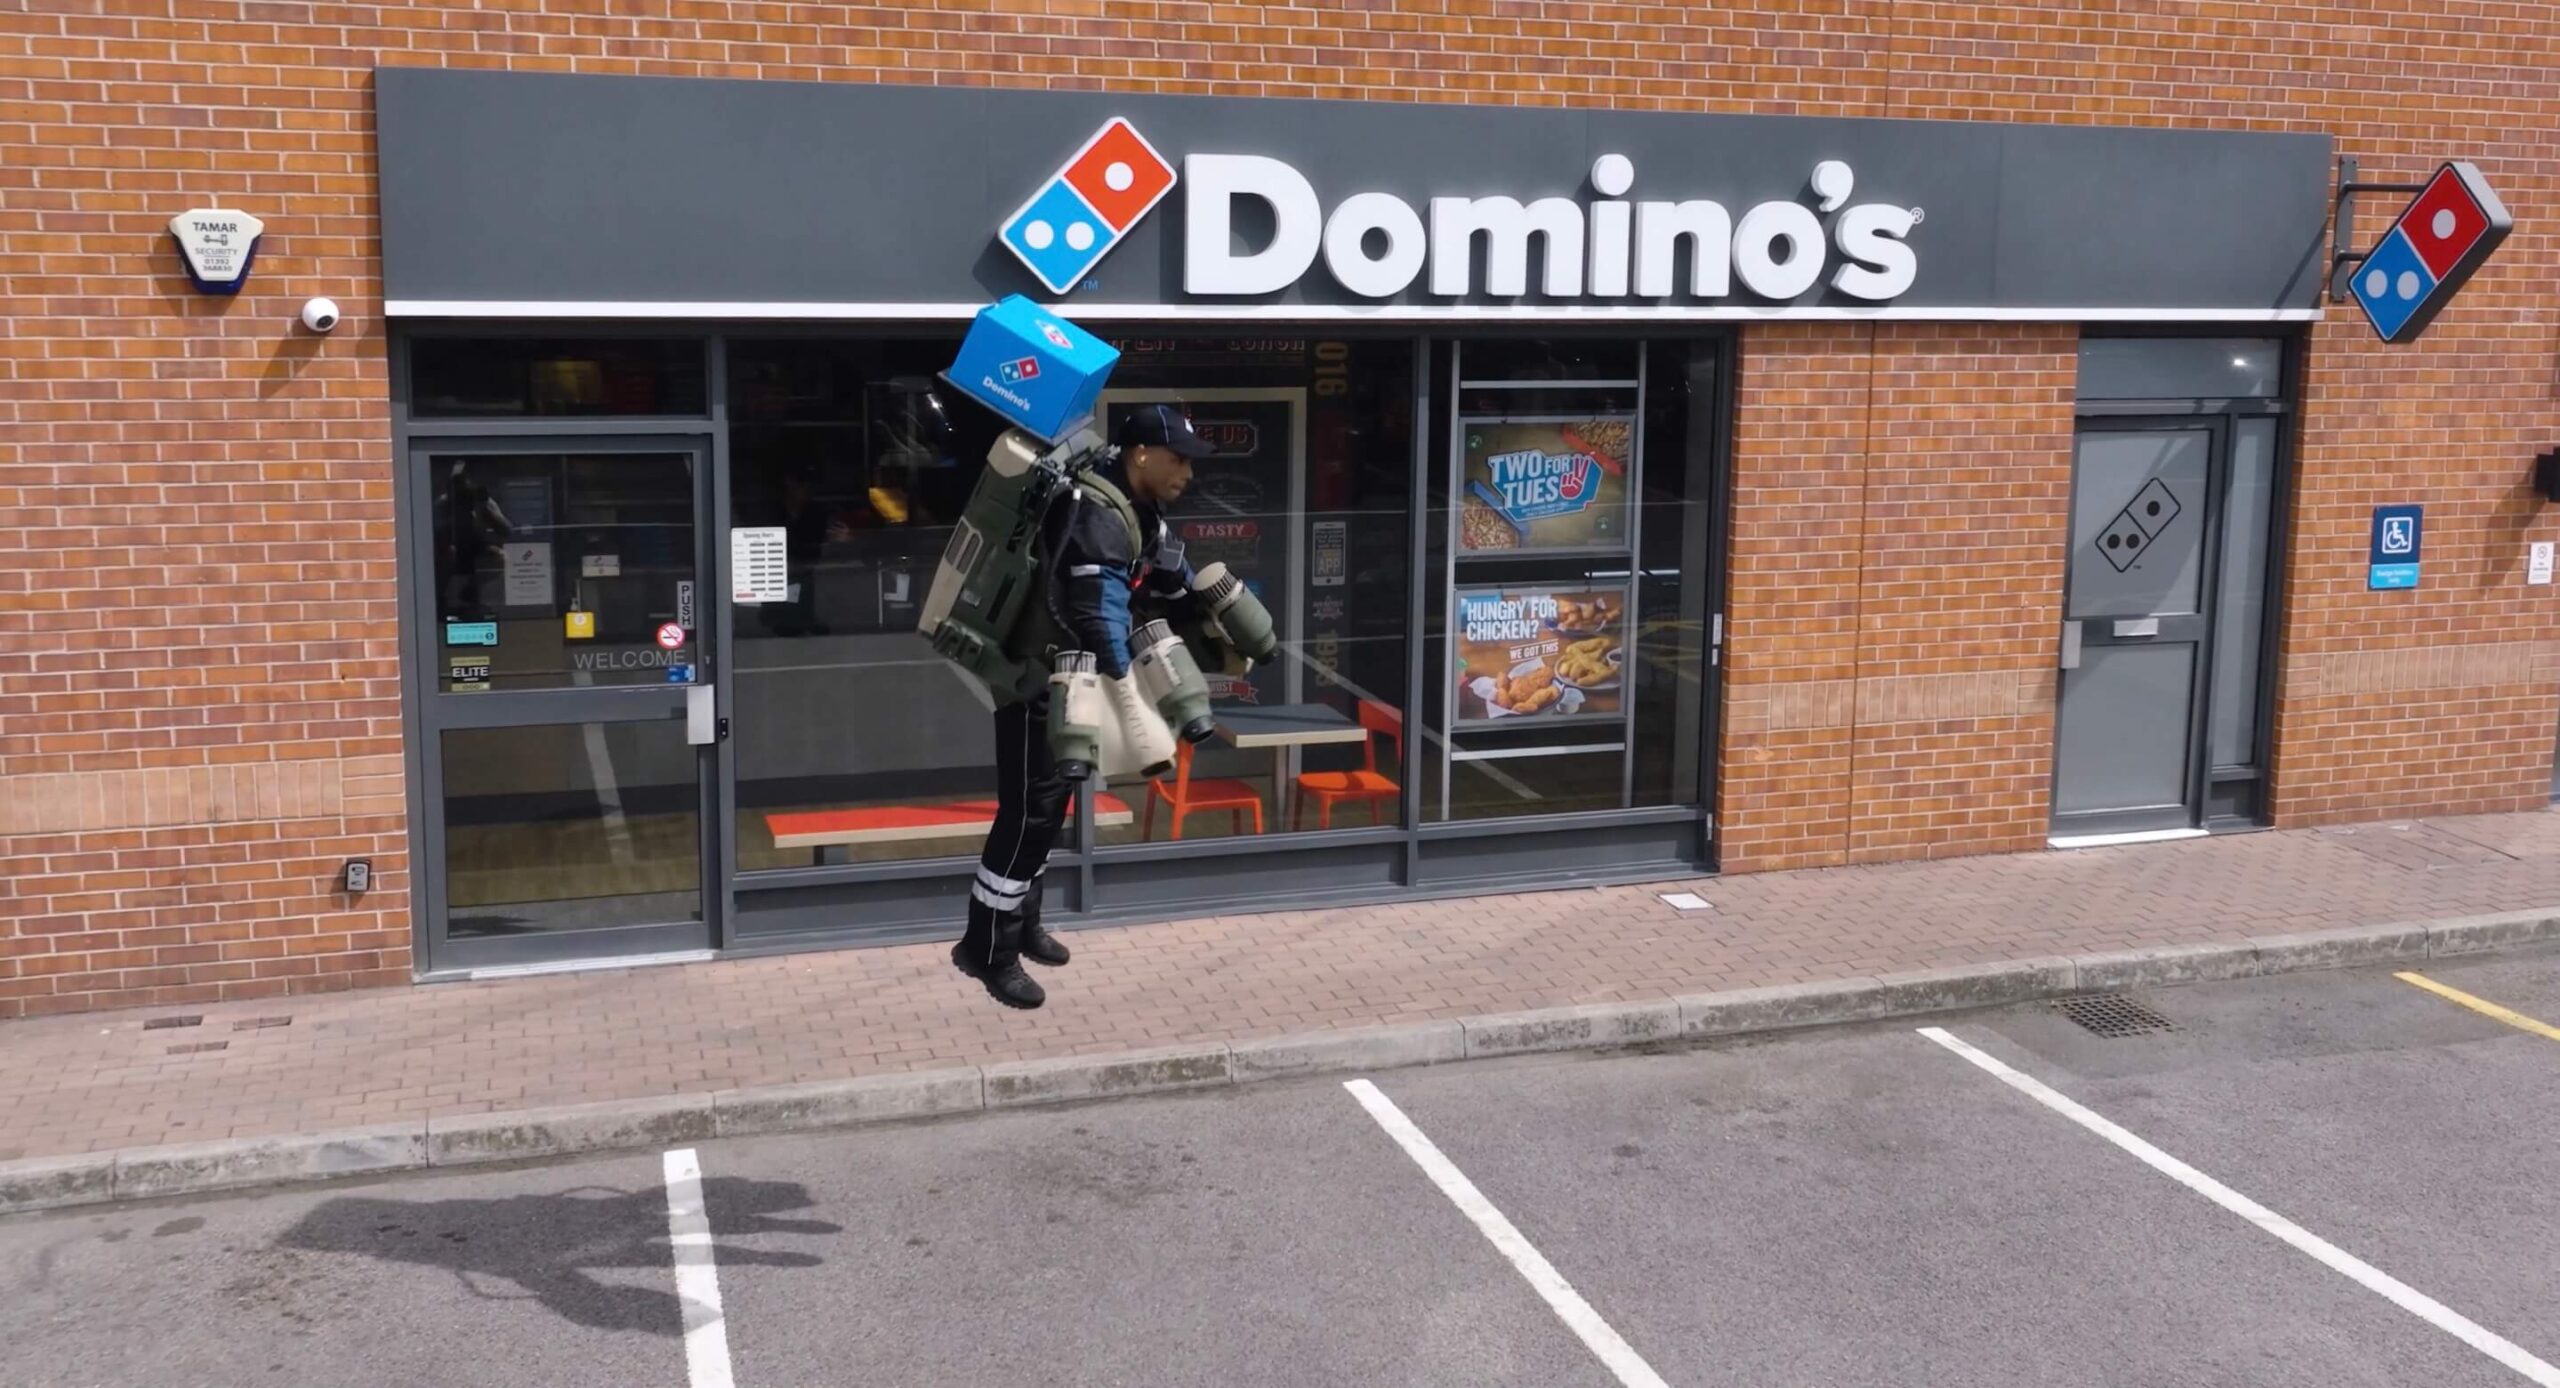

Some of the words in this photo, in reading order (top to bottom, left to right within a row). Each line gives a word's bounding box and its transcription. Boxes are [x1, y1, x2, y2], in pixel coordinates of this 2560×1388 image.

[193, 222, 238, 233] TAMAR
[1184, 154, 1917, 300] Domino's
[195, 247, 238, 256] SECURITY
[982, 375, 1031, 412] Domino's
[1488, 451, 1542, 483] TWO
[1544, 456, 1571, 475] FOR
[1503, 475, 1560, 508] TUES
[1197, 524, 1245, 537] TASTY
[681, 585, 691, 626] PUSH
[1467, 601, 1530, 621] HUNGRY
[1530, 599, 1558, 618] FOR
[1467, 620, 1540, 641] CHICKEN?
[574, 650, 686, 669] WELCOME
[1509, 648, 1523, 660] WE
[1524, 645, 1540, 658] GOT
[1542, 641, 1560, 655] THIS
[452, 666, 489, 678] ELITE
